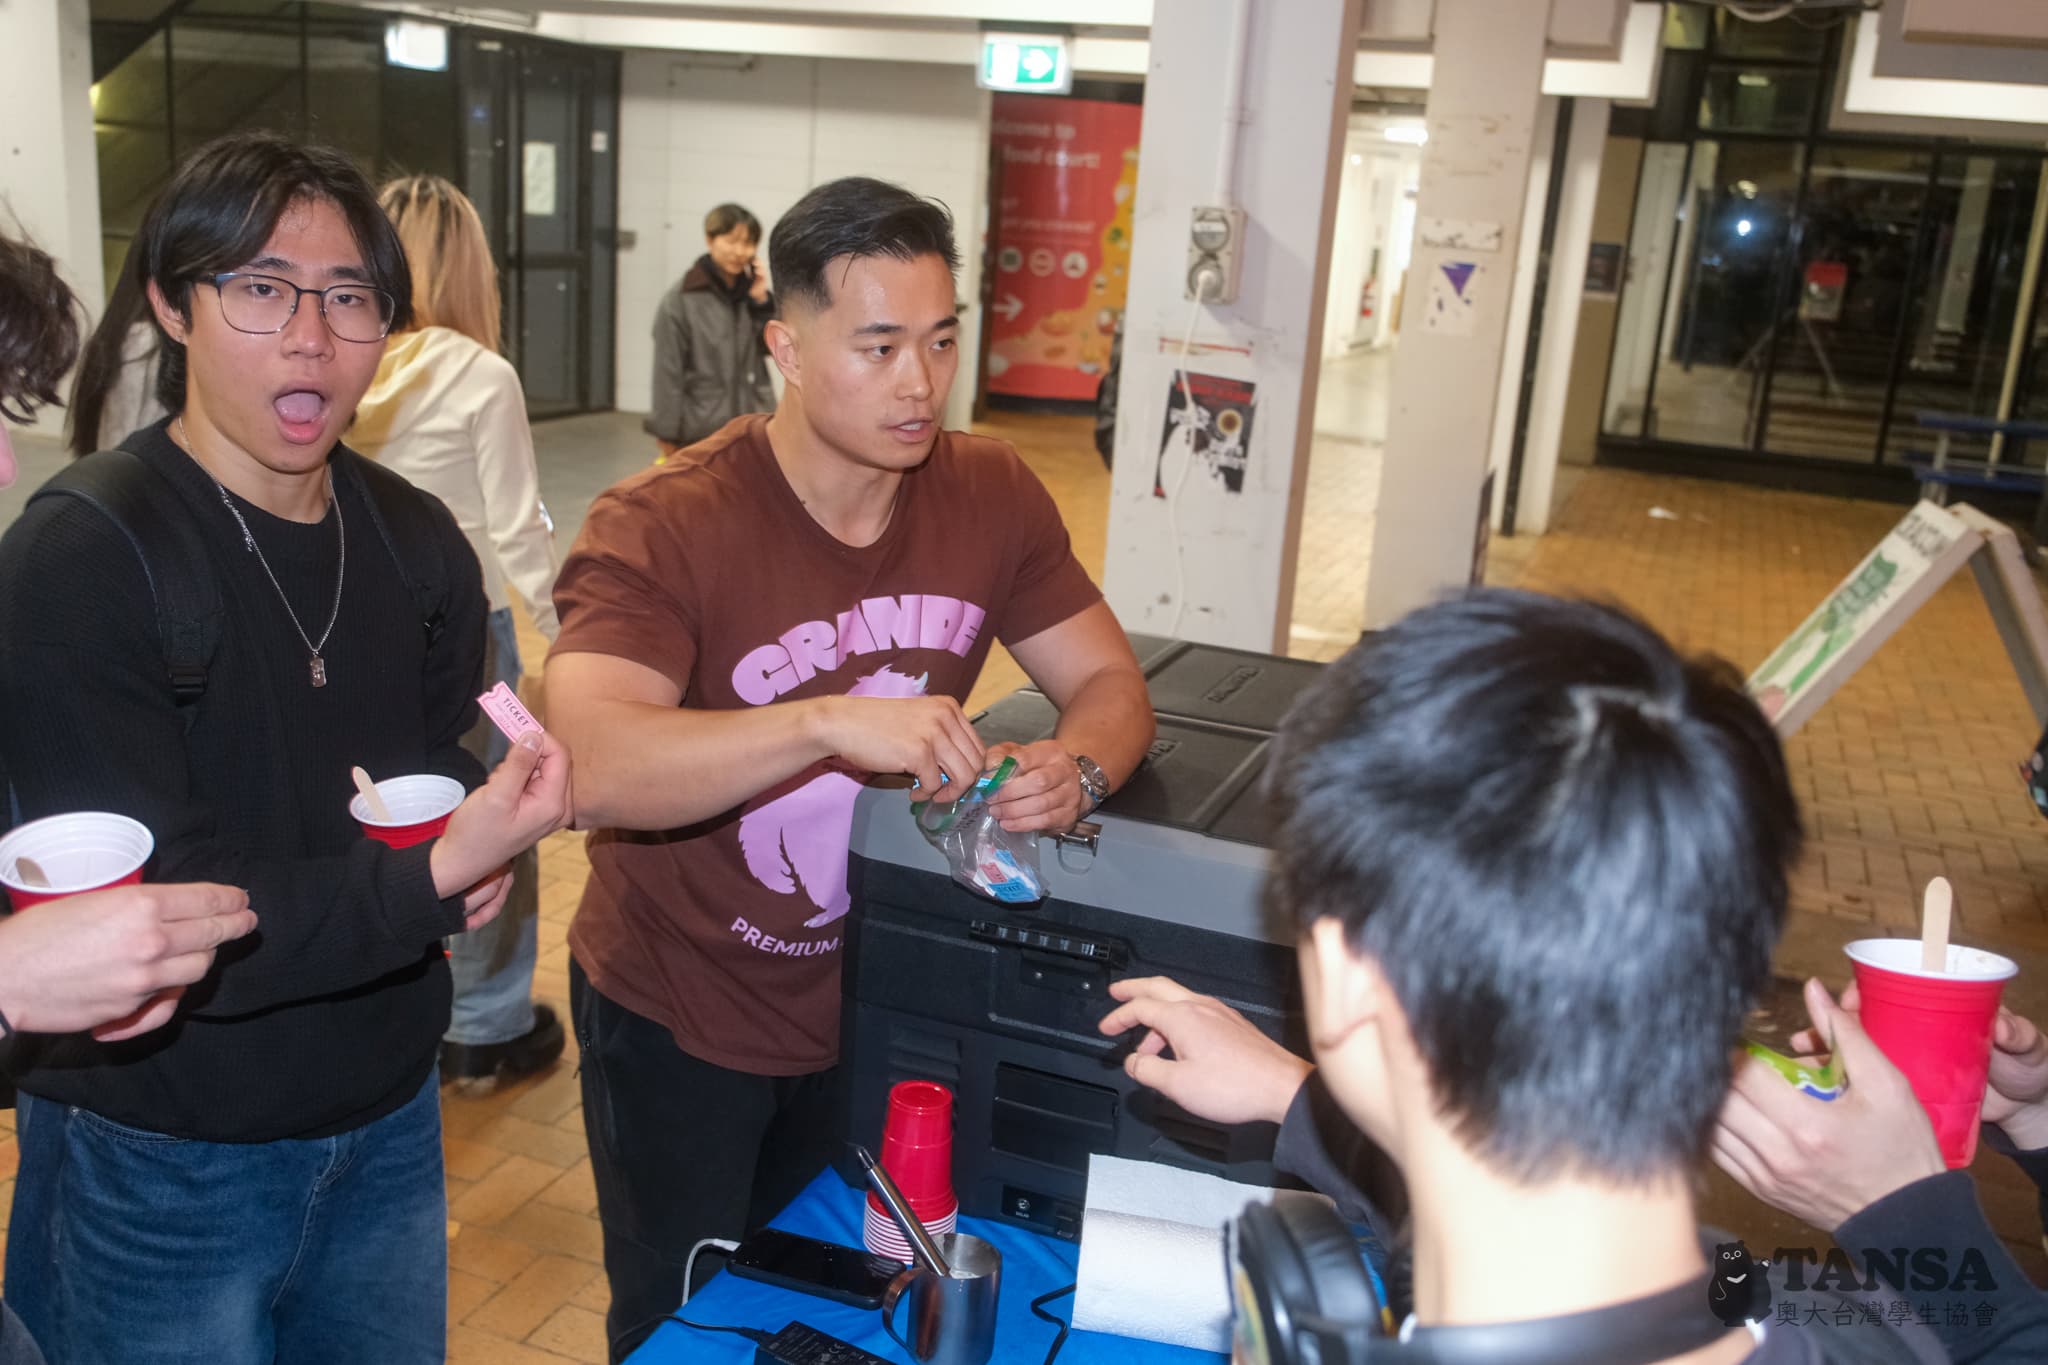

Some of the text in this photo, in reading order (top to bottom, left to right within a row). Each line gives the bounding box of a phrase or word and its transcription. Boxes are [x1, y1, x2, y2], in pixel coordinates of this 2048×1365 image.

[732, 594, 985, 706] GRANDE
[504, 698, 529, 726] TICKET
[730, 916, 839, 957] PREMIUM
